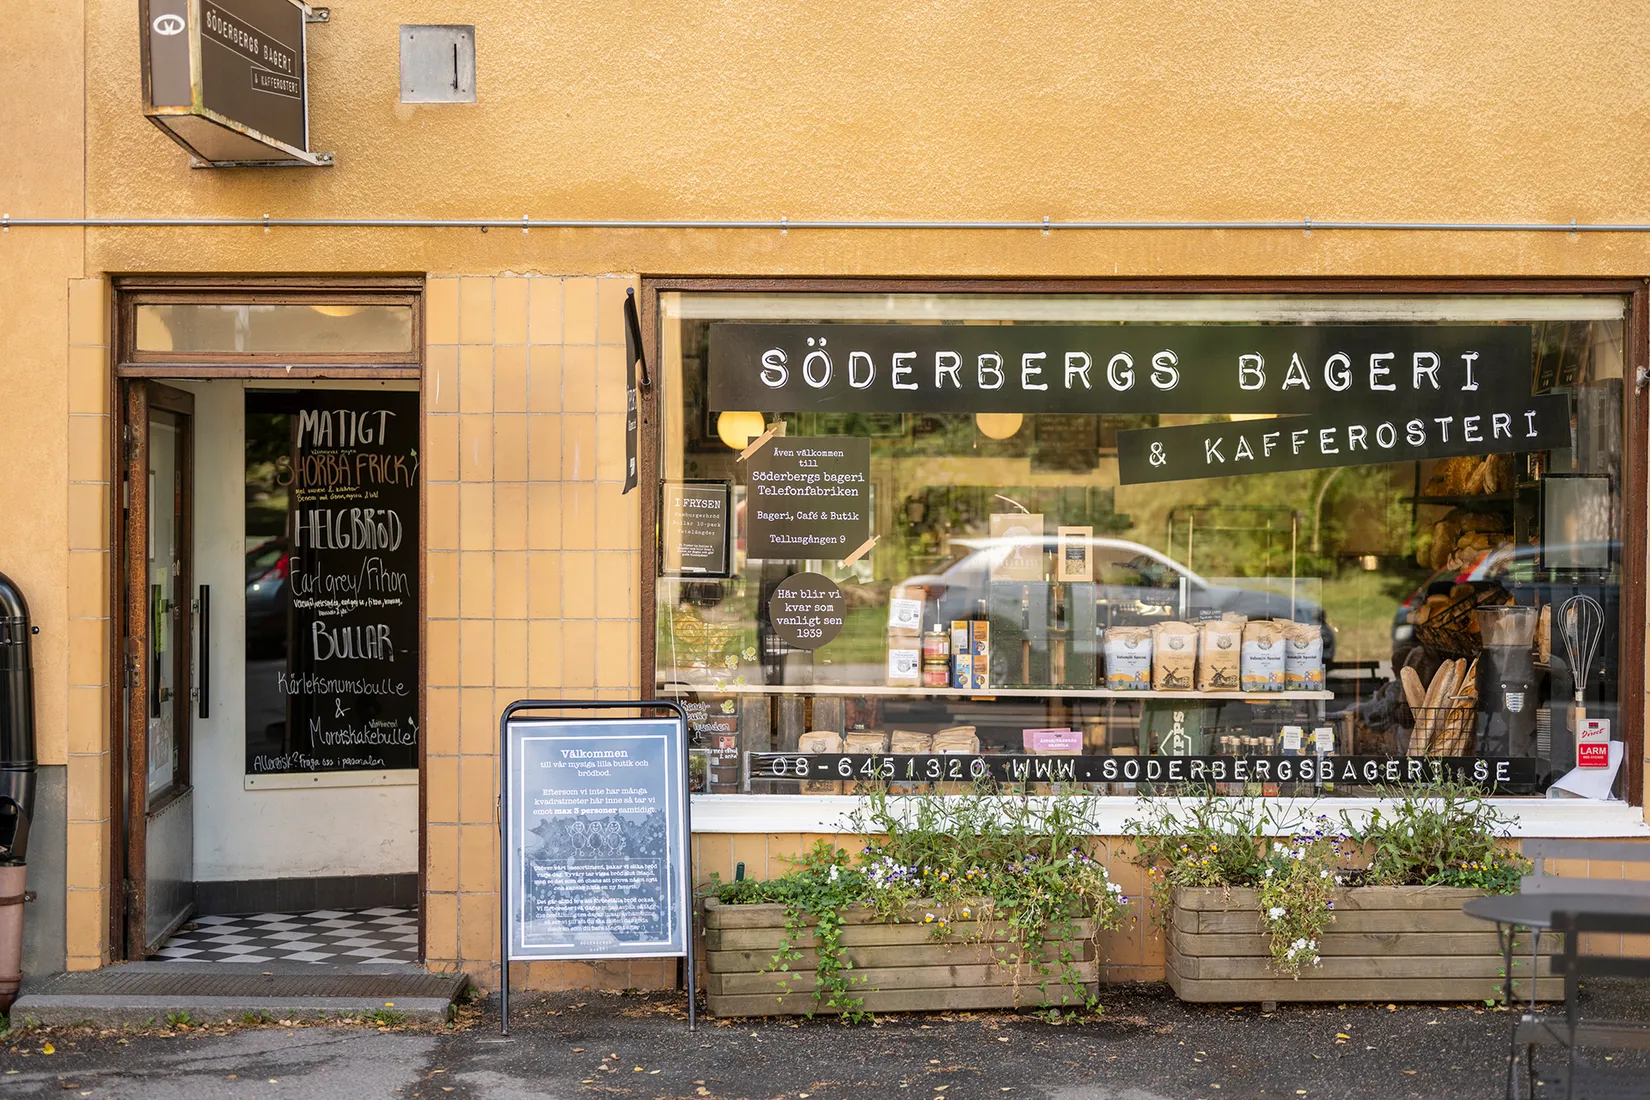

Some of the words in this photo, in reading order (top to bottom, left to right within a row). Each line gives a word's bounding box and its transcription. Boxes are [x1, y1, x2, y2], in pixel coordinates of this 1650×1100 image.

[206, 10, 259, 54] SÖDERBERGS
[264, 46, 292, 72] BAGERI
[261, 78, 298, 94] KAFFEROSTERI
[760, 337, 1180, 391] SÖDERBERGS
[1238, 350, 1480, 392] BAGERI
[297, 409, 396, 448] MATIGT
[1149, 441, 1166, 467] &
[1204, 409, 1538, 465] KAFFEROSTERI
[774, 448, 794, 456] Även
[796, 448, 844, 456] välkommen
[276, 454, 350, 486] SHORBA
[752, 471, 820, 484] Söderbergs
[823, 472, 865, 484] bageri
[757, 486, 859, 496] Telefonfabriken
[683, 499, 721, 508] FRYSEN
[757, 511, 794, 521] Bageri,
[796, 511, 818, 520] Café
[830, 512, 859, 520] Butik
[769, 534, 837, 545] Tellusgången
[840, 535, 846, 543] 9
[290, 557, 322, 596] Earl
[778, 589, 797, 598] Här
[800, 589, 826, 598] blir
[828, 589, 842, 598] vi
[785, 603, 811, 612] kvar
[776, 616, 821, 626] vanligt
[797, 629, 823, 638] 1939
[312, 620, 394, 661] BULLAR
[335, 698, 350, 718] &
[1582, 728, 1606, 738] Direct
[560, 749, 629, 758] Välkommen
[1580, 747, 1606, 755] LARM
[568, 760, 596, 769] mysiga
[772, 758, 986, 778] 08-6451320
[621, 787, 647, 795] många
[618, 806, 657, 815] samtidigt.
